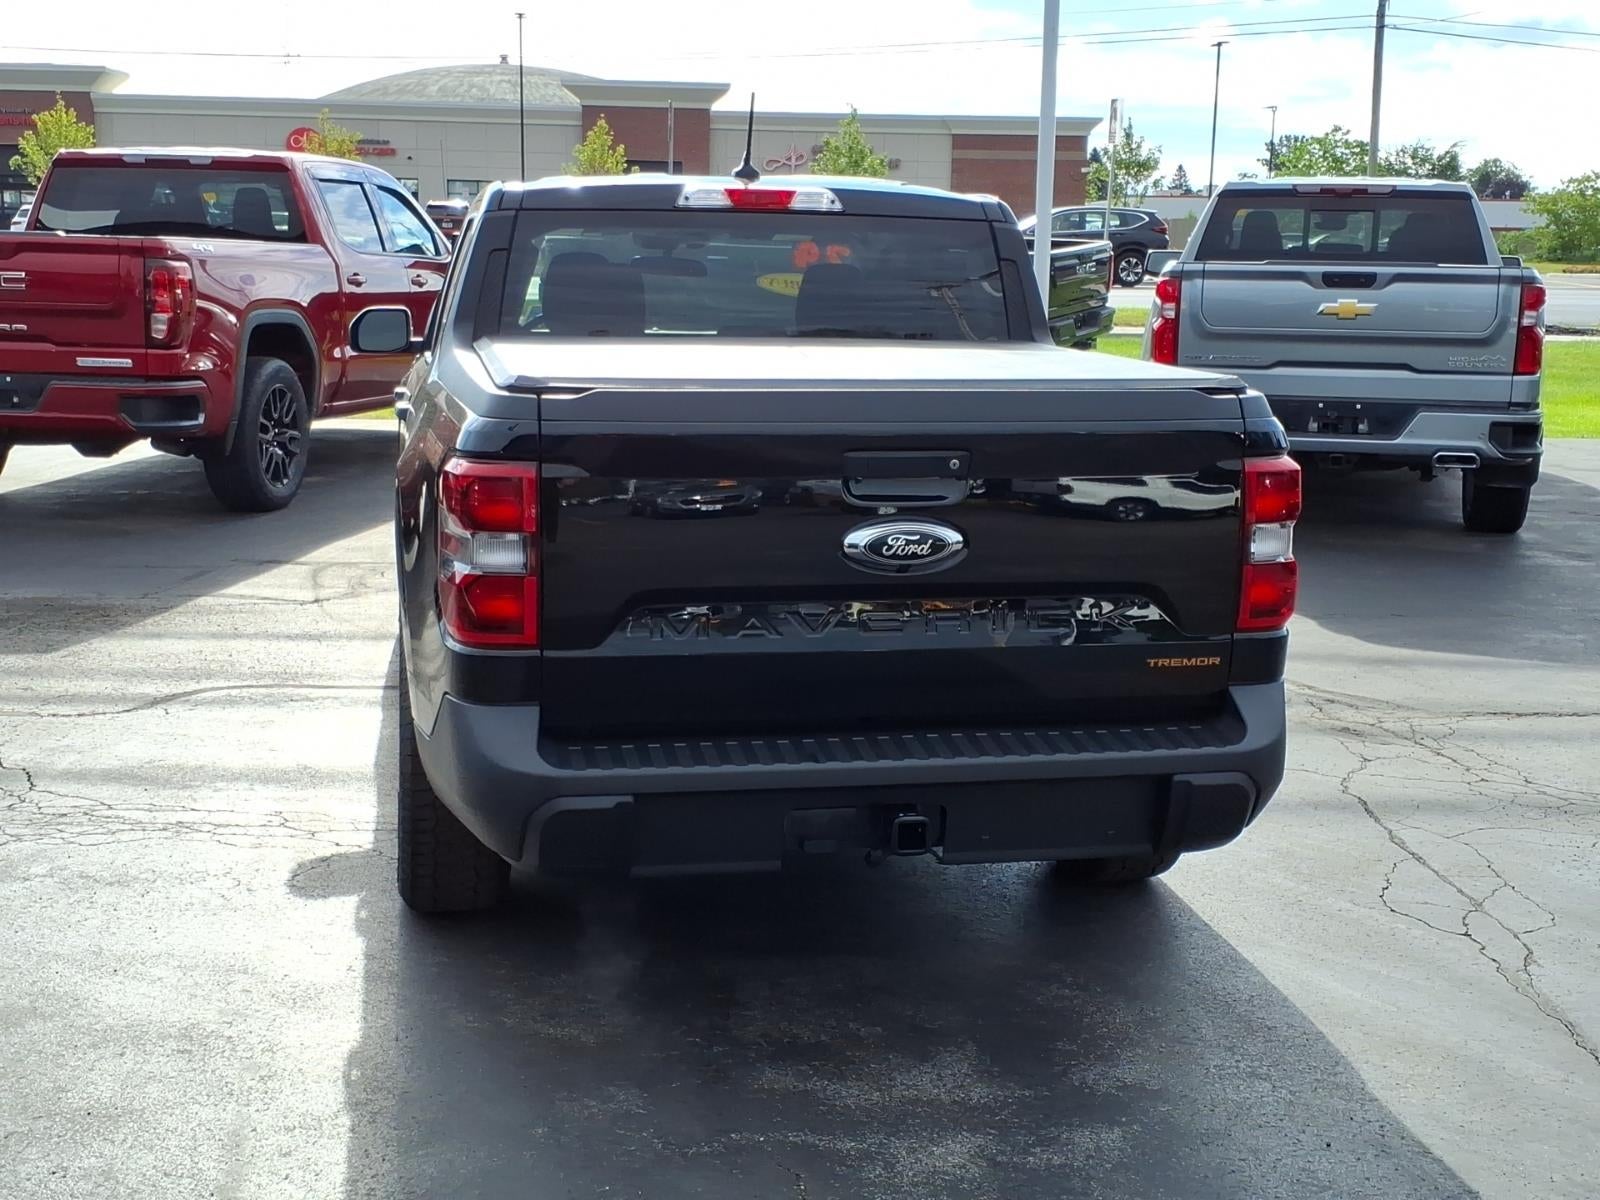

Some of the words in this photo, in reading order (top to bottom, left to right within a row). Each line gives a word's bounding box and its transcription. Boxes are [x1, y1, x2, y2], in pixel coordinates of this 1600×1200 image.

[882, 533, 934, 556] Ford
[650, 603, 1137, 641] MAVERICK
[1145, 656, 1222, 668] TREMOR
